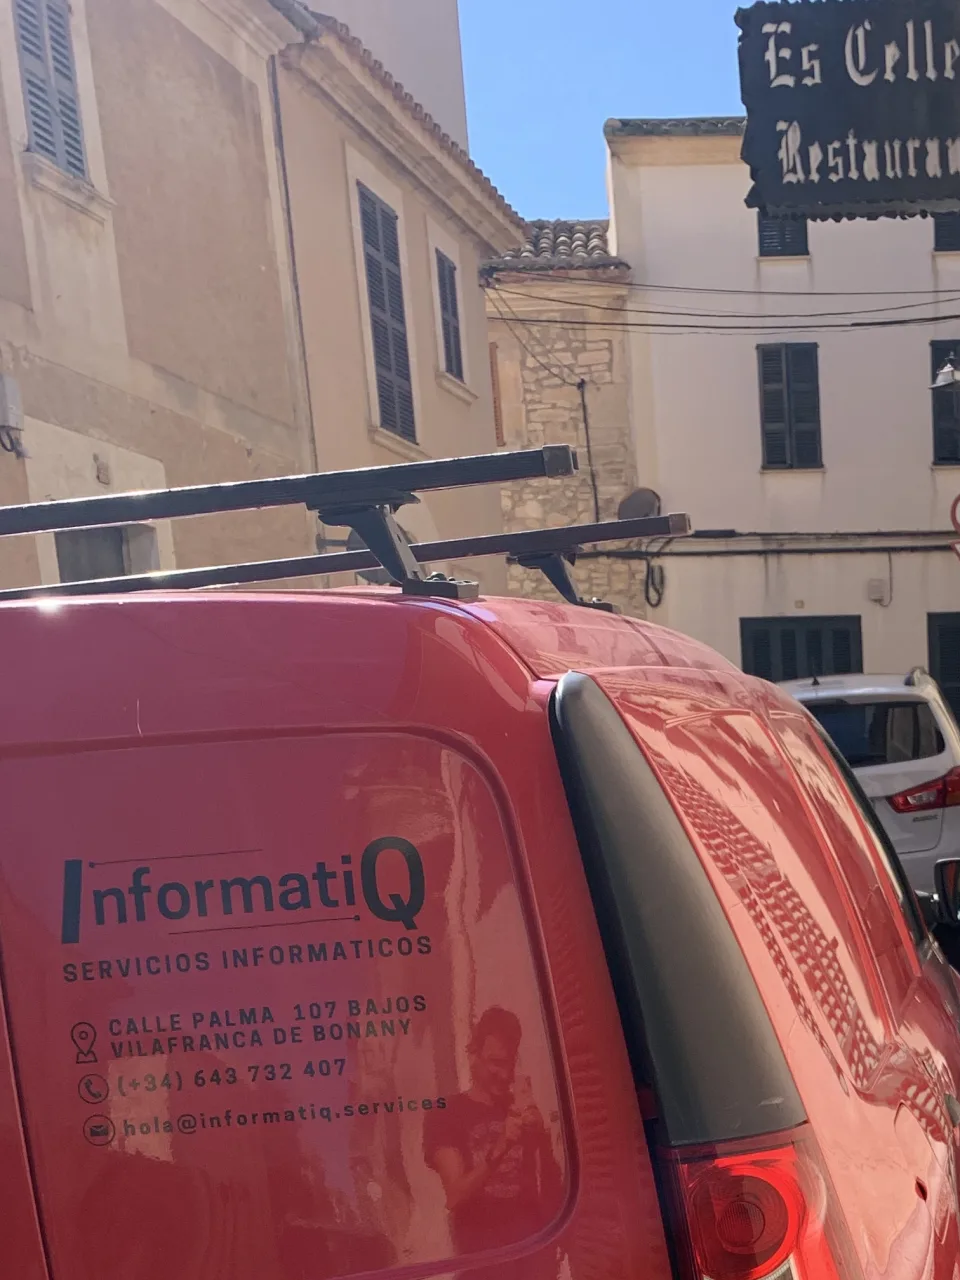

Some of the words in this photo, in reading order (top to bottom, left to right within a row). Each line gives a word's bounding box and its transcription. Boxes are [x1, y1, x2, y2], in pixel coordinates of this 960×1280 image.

[761, 20, 822, 88] Es
[61, 836, 426, 945] InformatiQ
[63, 952, 211, 982] SERVICIOS
[222, 935, 433, 969] INFORMATICOS
[109, 1014, 182, 1036] CALLE
[192, 1006, 275, 1029] PALMA
[294, 1001, 337, 1021] 107
[348, 995, 427, 1016] BAJOS
[110, 1030, 263, 1058] VILAFRANCA
[273, 1026, 303, 1045] DE
[313, 1018, 411, 1041] BONANY
[117, 1071, 183, 1096] (+34)
[194, 1067, 238, 1087] 643
[248, 1063, 292, 1083] 732
[303, 1058, 346, 1078] 407
[123, 1096, 447, 1136] hola@informatiq.services
